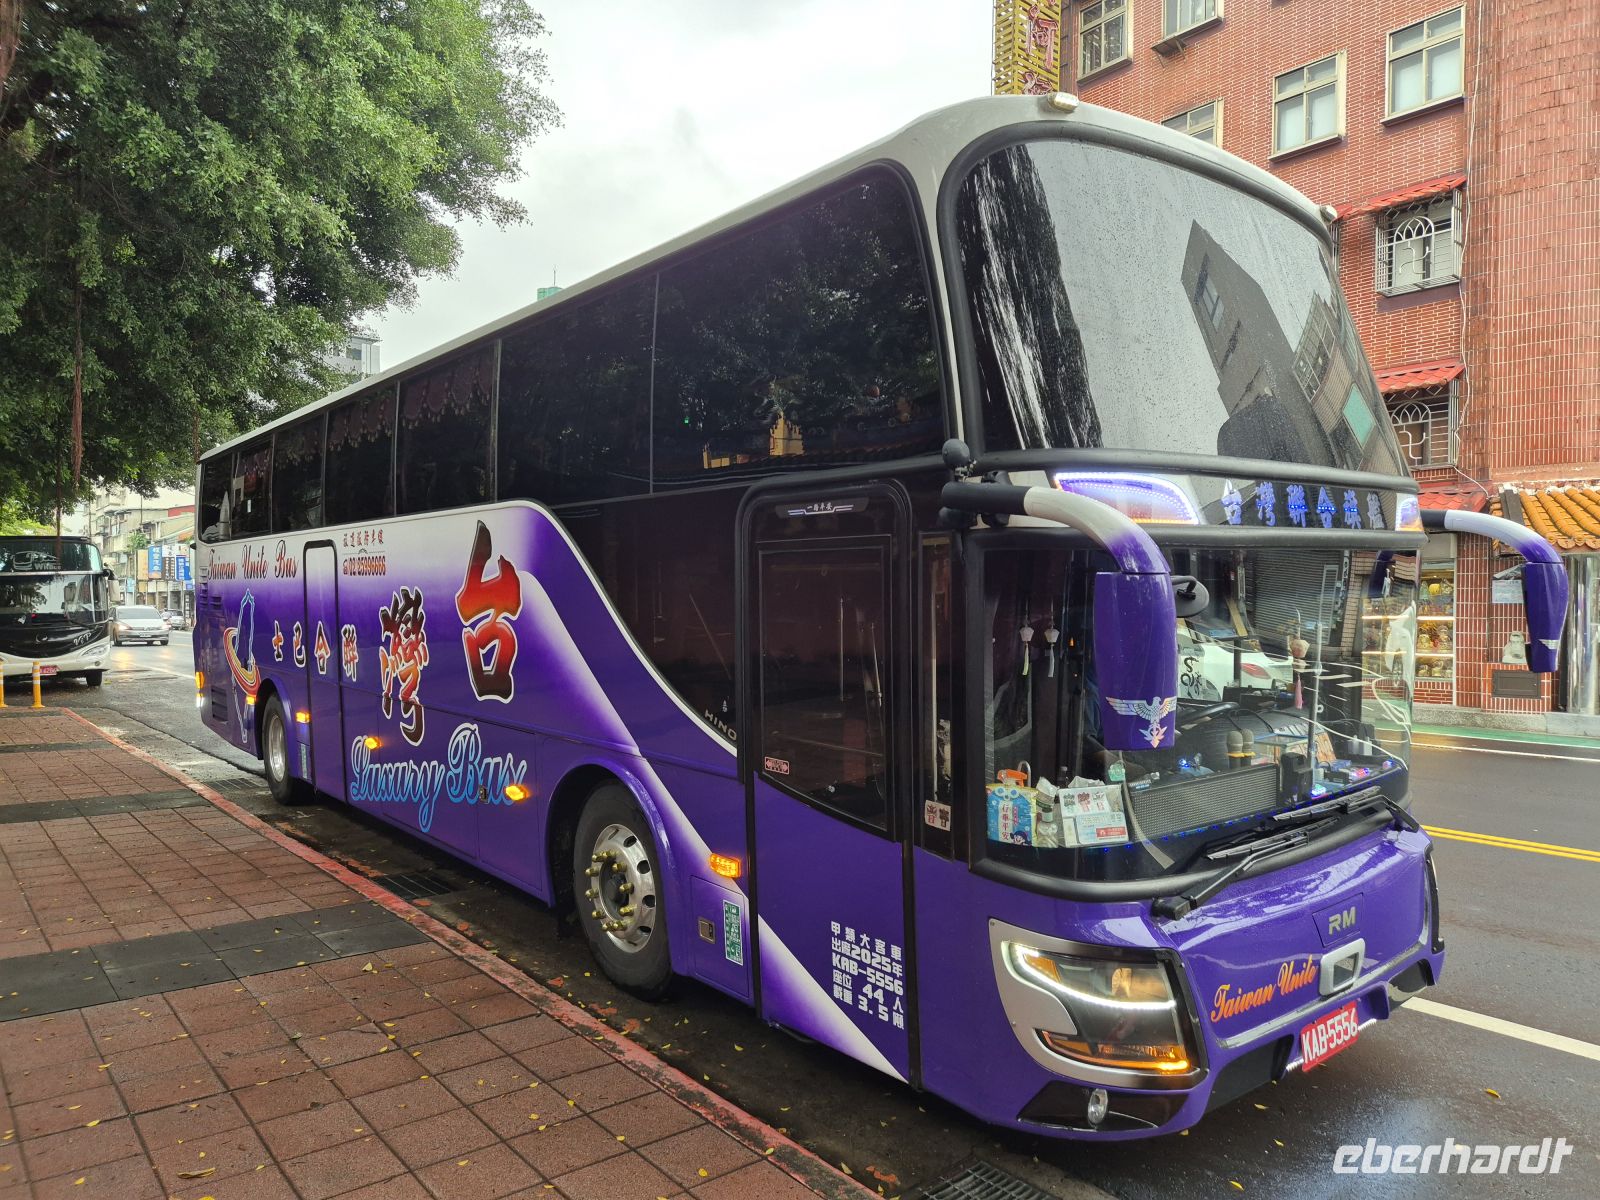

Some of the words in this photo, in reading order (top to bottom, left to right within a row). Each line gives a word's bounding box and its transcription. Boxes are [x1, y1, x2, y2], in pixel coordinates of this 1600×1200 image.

[208, 548, 237, 580] Taiwan
[242, 544, 269, 580] Unite
[275, 540, 299, 578] Bus
[704, 709, 737, 741] HINO
[350, 735, 446, 833] Luxury
[446, 722, 527, 806] Bus
[1328, 905, 1357, 935] RM
[831, 920, 902, 962] 甲類大客車
[831, 952, 904, 996] KAB-5556
[862, 983, 885, 1005] 44
[1210, 983, 1276, 1023] Taiwan
[1277, 954, 1319, 998] Unite
